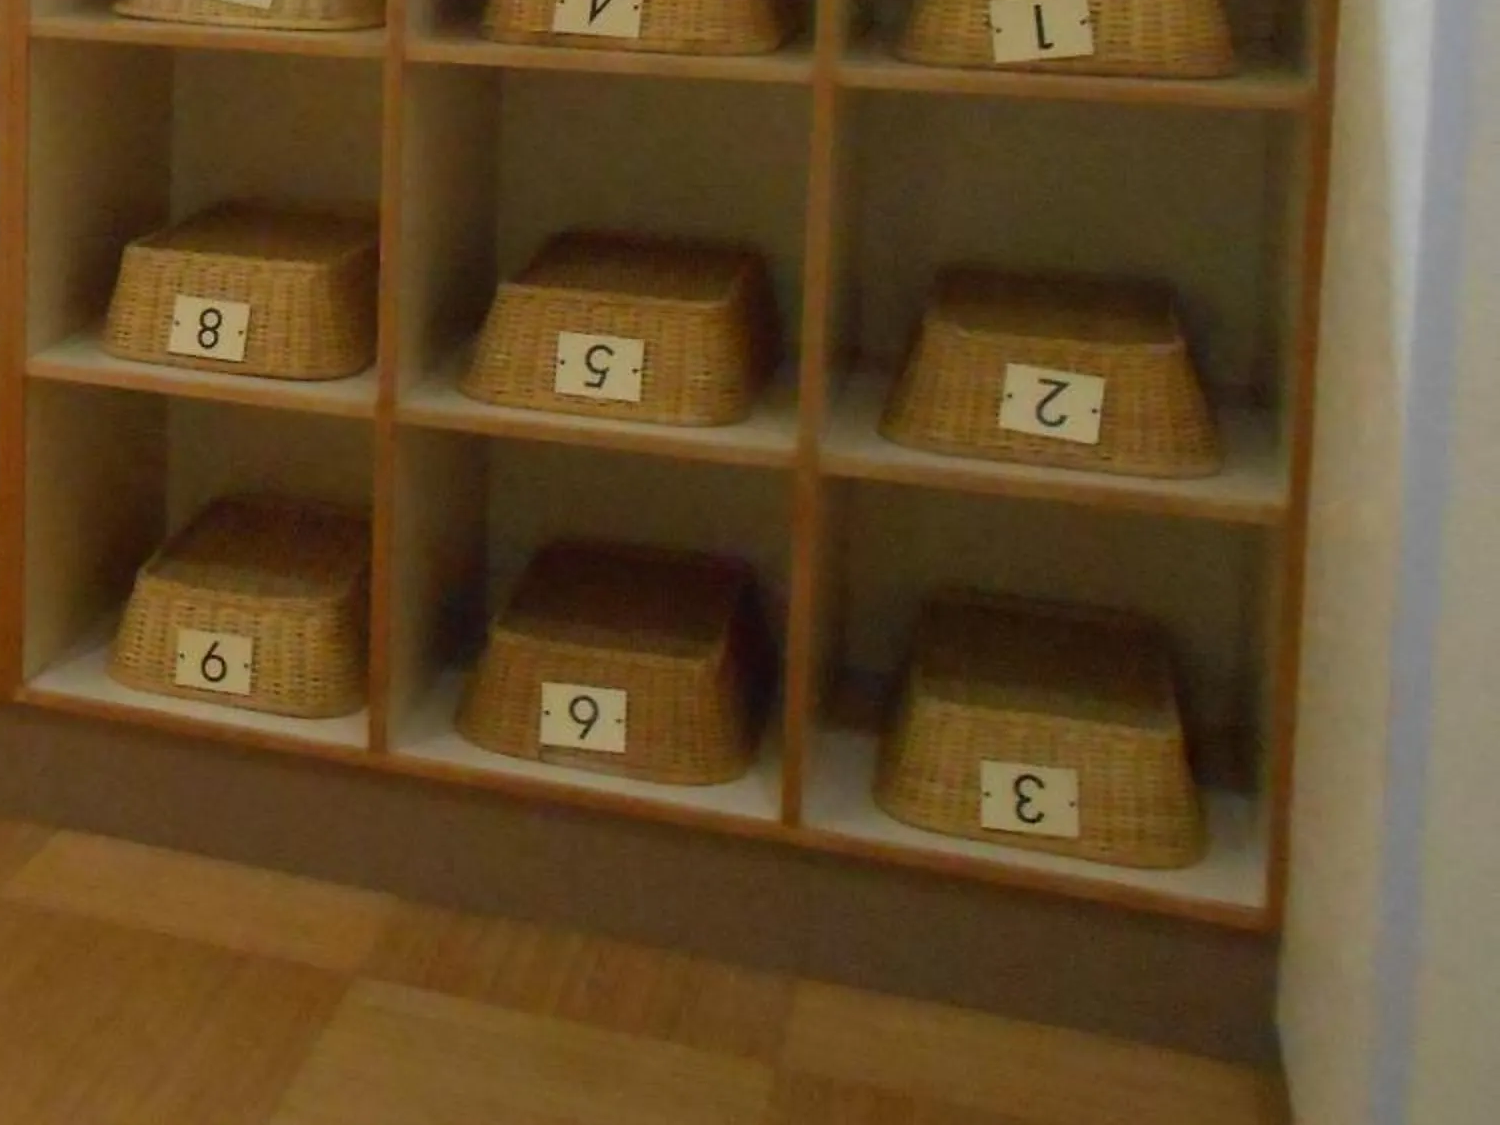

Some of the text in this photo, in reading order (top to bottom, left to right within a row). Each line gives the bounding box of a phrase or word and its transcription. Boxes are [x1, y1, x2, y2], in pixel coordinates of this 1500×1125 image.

[1033, 3, 1055, 51] 1
[197, 307, 223, 350] 8
[583, 344, 615, 390] 5
[1035, 378, 1070, 428] 2
[200, 640, 228, 684] 9
[567, 694, 600, 740] 6
[1011, 772, 1047, 826] 3
